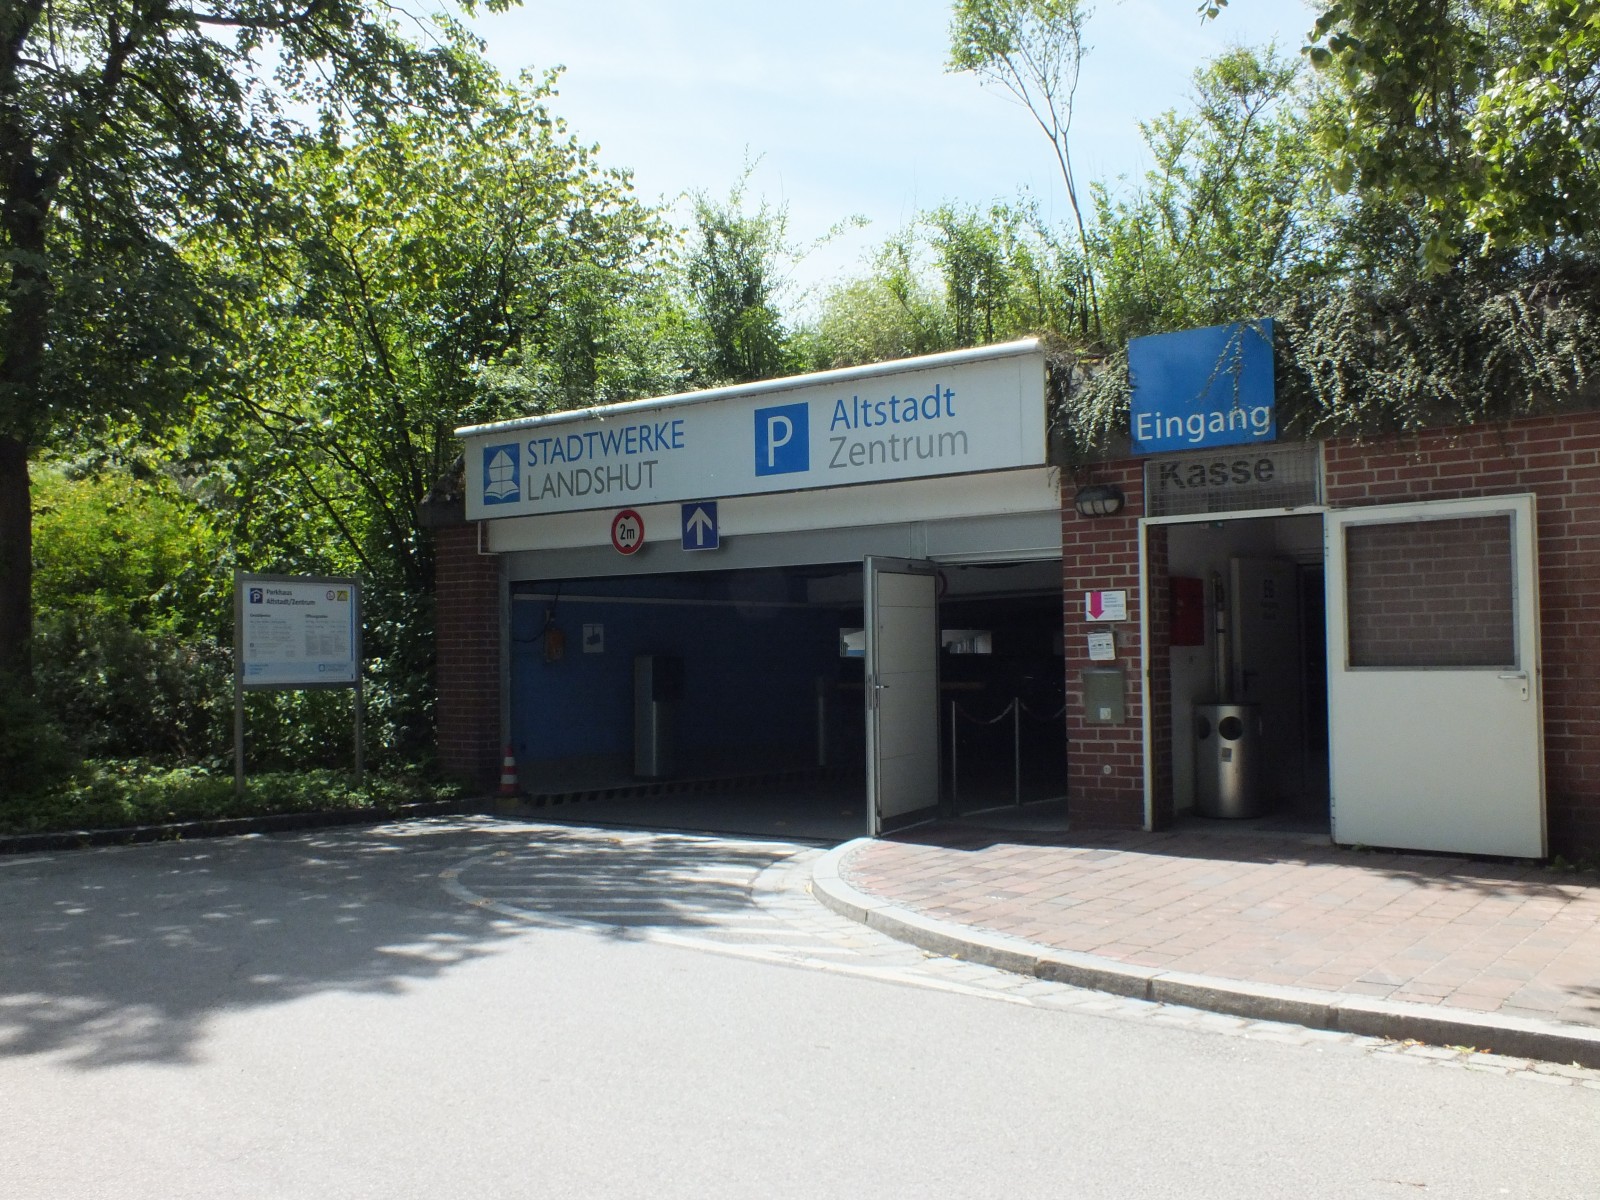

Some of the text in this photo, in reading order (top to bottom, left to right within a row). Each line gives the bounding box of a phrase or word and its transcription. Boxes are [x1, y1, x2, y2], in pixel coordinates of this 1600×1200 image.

[830, 384, 956, 431] Altstadt
[1137, 406, 1270, 443] Eingang
[528, 420, 684, 467] STADTWERKE
[768, 415, 793, 467] P
[829, 430, 968, 469] Zentrum
[528, 460, 658, 500] LANDSHUT
[1160, 458, 1275, 490] Kasse
[620, 523, 635, 540] 2m
